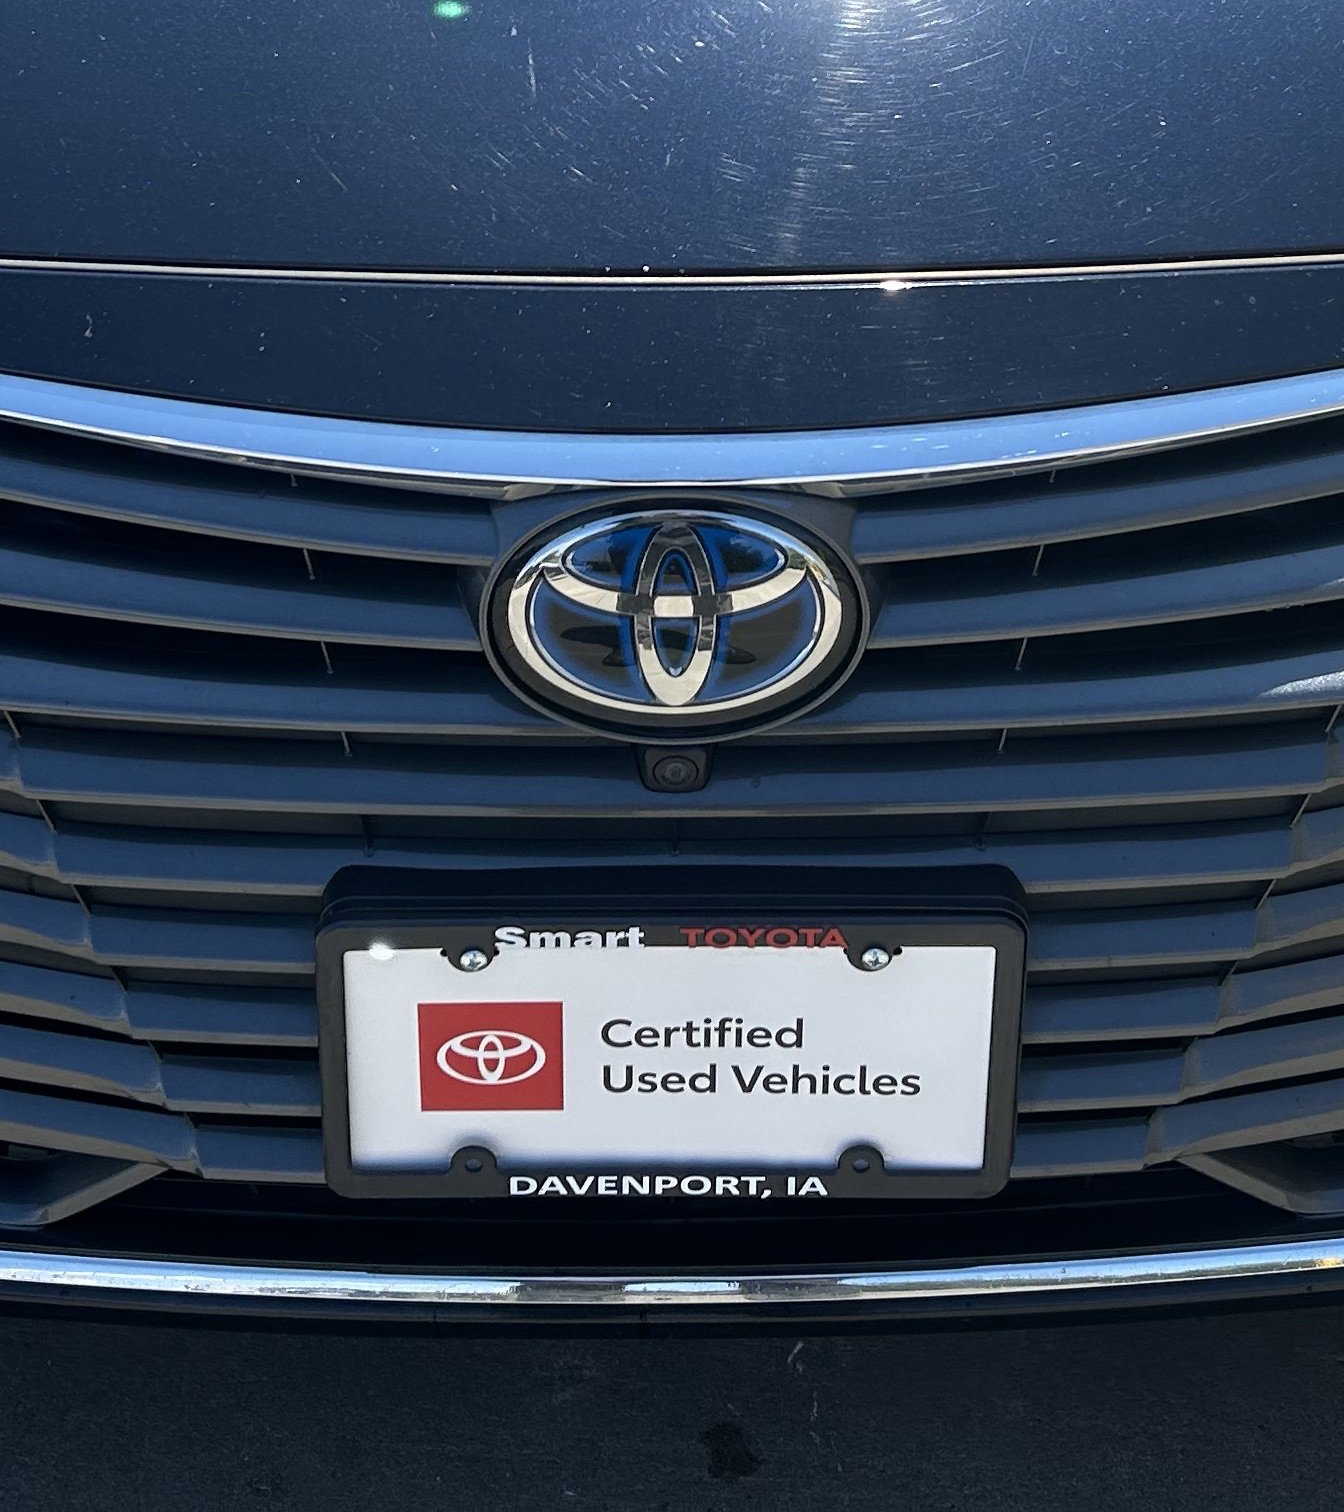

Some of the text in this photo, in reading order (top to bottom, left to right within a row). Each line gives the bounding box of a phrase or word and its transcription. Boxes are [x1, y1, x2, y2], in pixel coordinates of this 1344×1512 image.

[494, 926, 849, 948] Smart TOYOTA
[601, 1018, 804, 1048] Certified
[603, 1064, 922, 1096] Used Vehicles
[509, 1175, 829, 1200] DAVENPORT, IA
